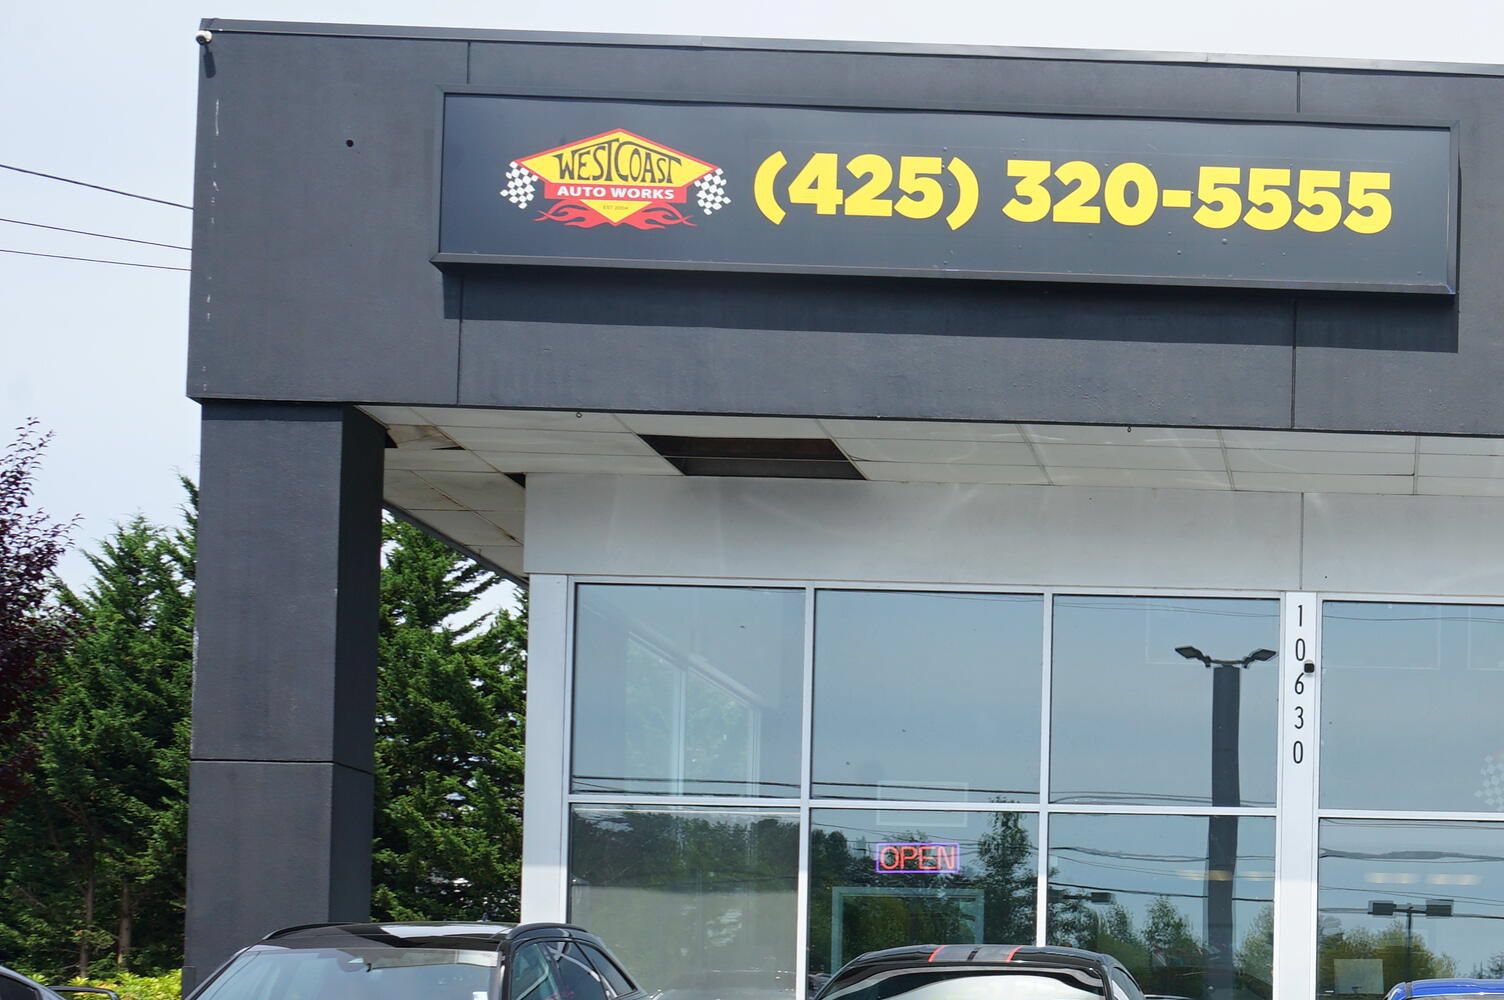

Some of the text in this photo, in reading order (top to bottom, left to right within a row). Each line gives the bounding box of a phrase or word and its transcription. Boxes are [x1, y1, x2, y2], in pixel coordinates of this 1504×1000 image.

[552, 138, 682, 184] WESTCOAST
[556, 186, 675, 200] AUTO WORKS
[754, 152, 1392, 234] (425) 320-5555
[880, 845, 956, 870] OPEN
